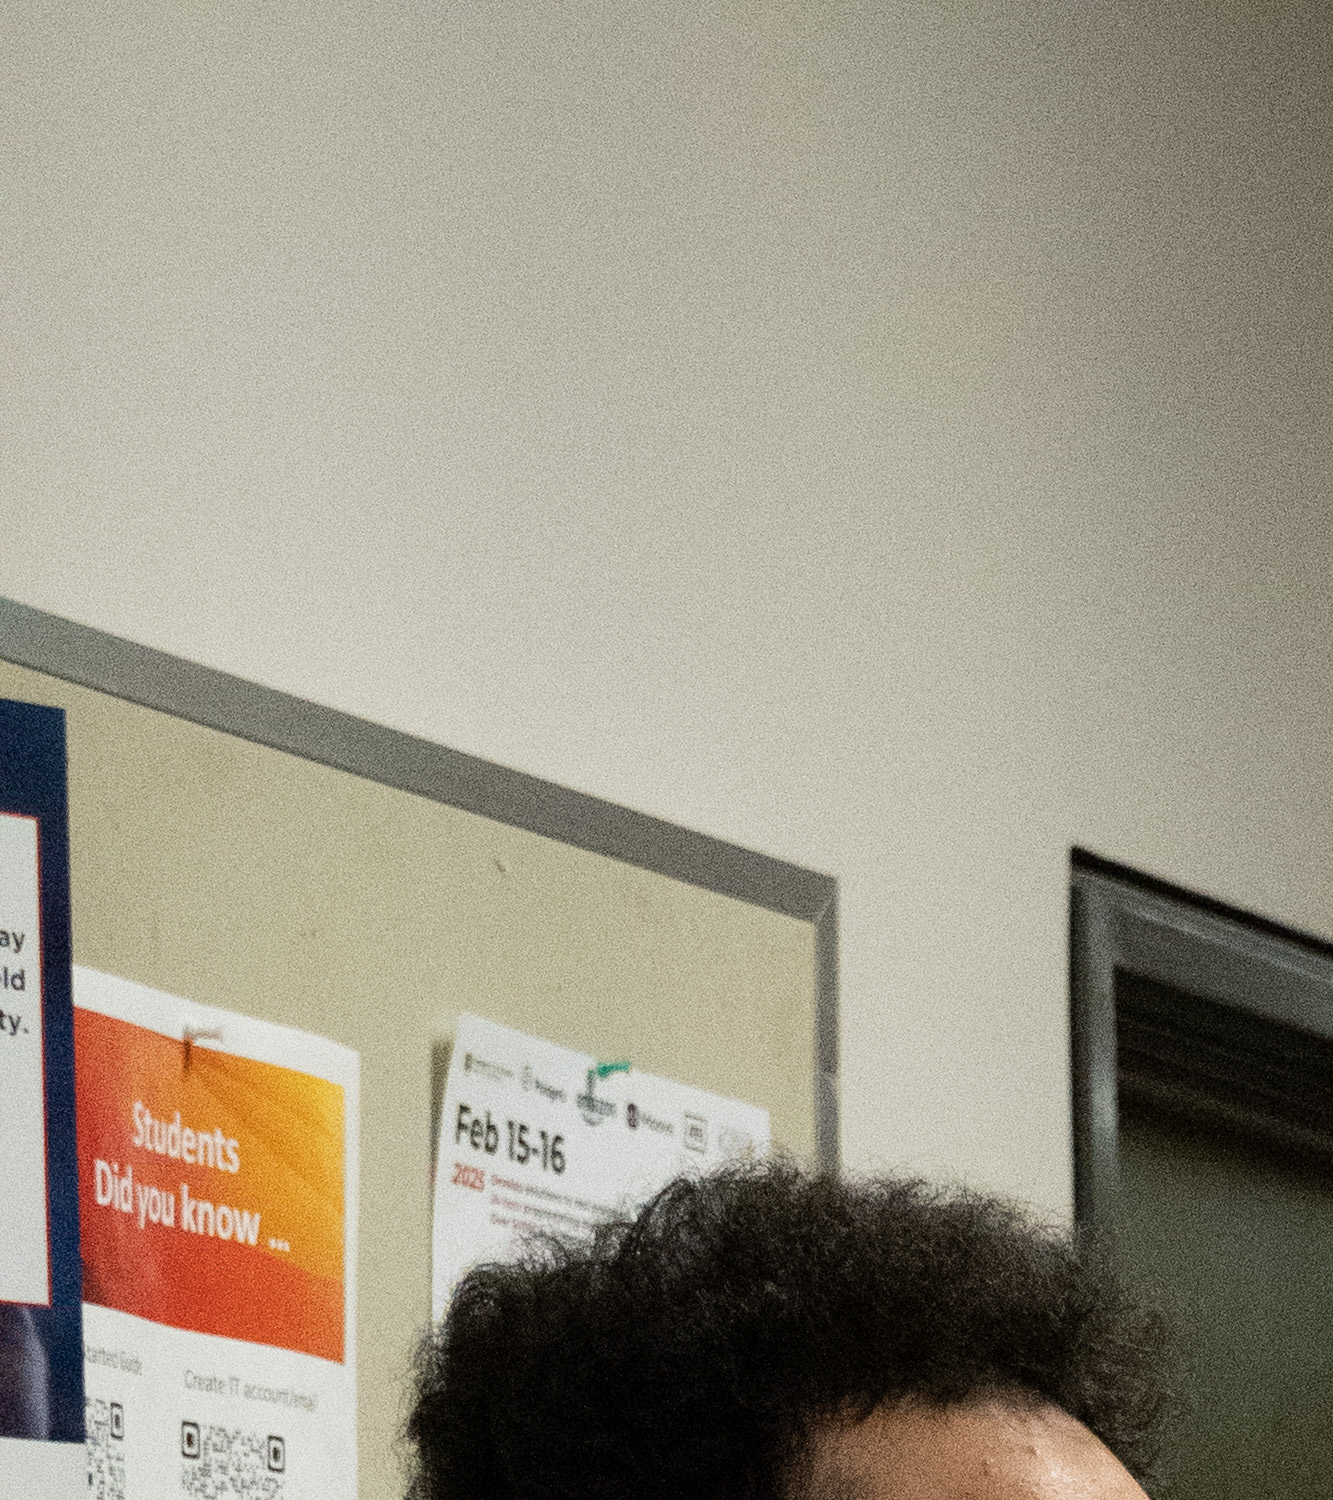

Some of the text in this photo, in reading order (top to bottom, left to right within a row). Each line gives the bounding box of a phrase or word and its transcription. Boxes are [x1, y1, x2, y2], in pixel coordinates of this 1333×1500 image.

[132, 1100, 240, 1173] Students
[456, 1104, 566, 1174] Feb 15-16
[94, 1158, 132, 1213] Did
[135, 1183, 174, 1230] you
[180, 1183, 261, 1246] know
[452, 1163, 485, 1192] 2025
[184, 1369, 223, 1393] Create
